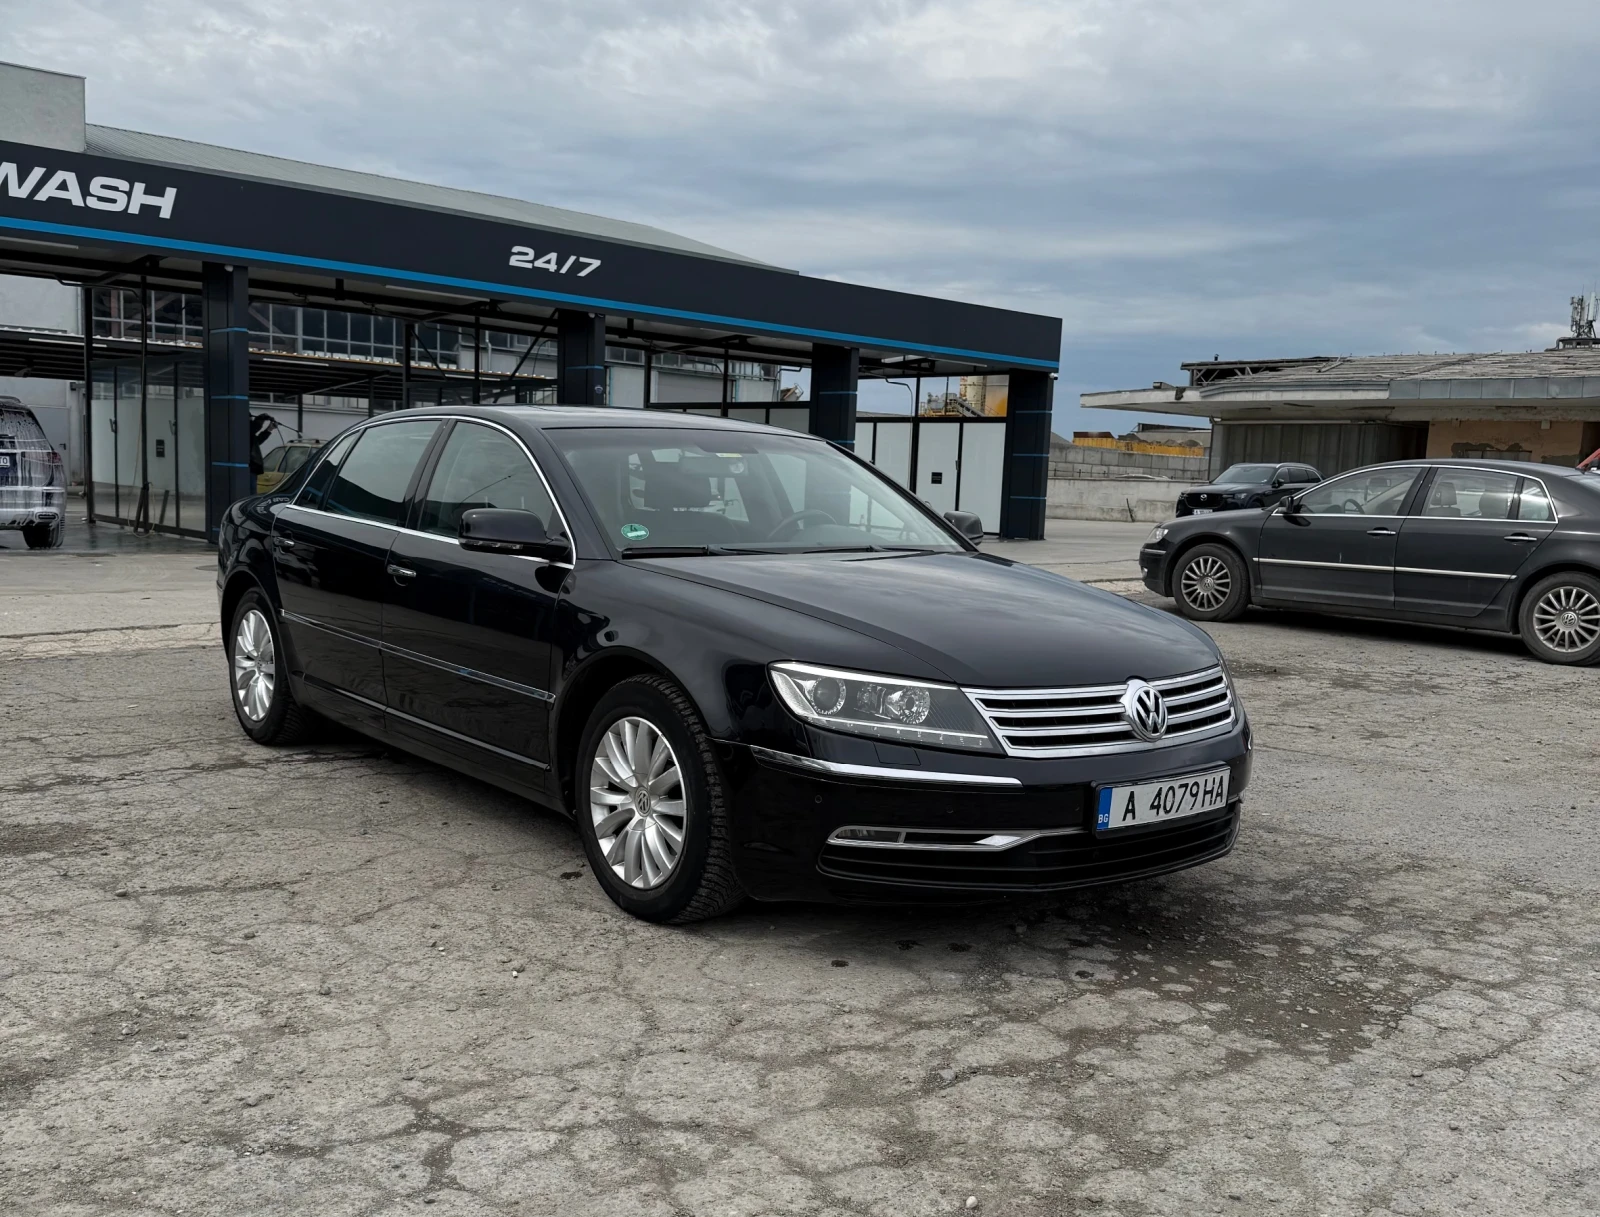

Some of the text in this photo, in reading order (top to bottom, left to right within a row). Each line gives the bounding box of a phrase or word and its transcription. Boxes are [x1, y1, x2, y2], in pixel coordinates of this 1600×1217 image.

[0, 161, 177, 219] WASH
[508, 245, 602, 277] 24/7
[1097, 813, 1109, 824] BG
[1121, 790, 1136, 821] A
